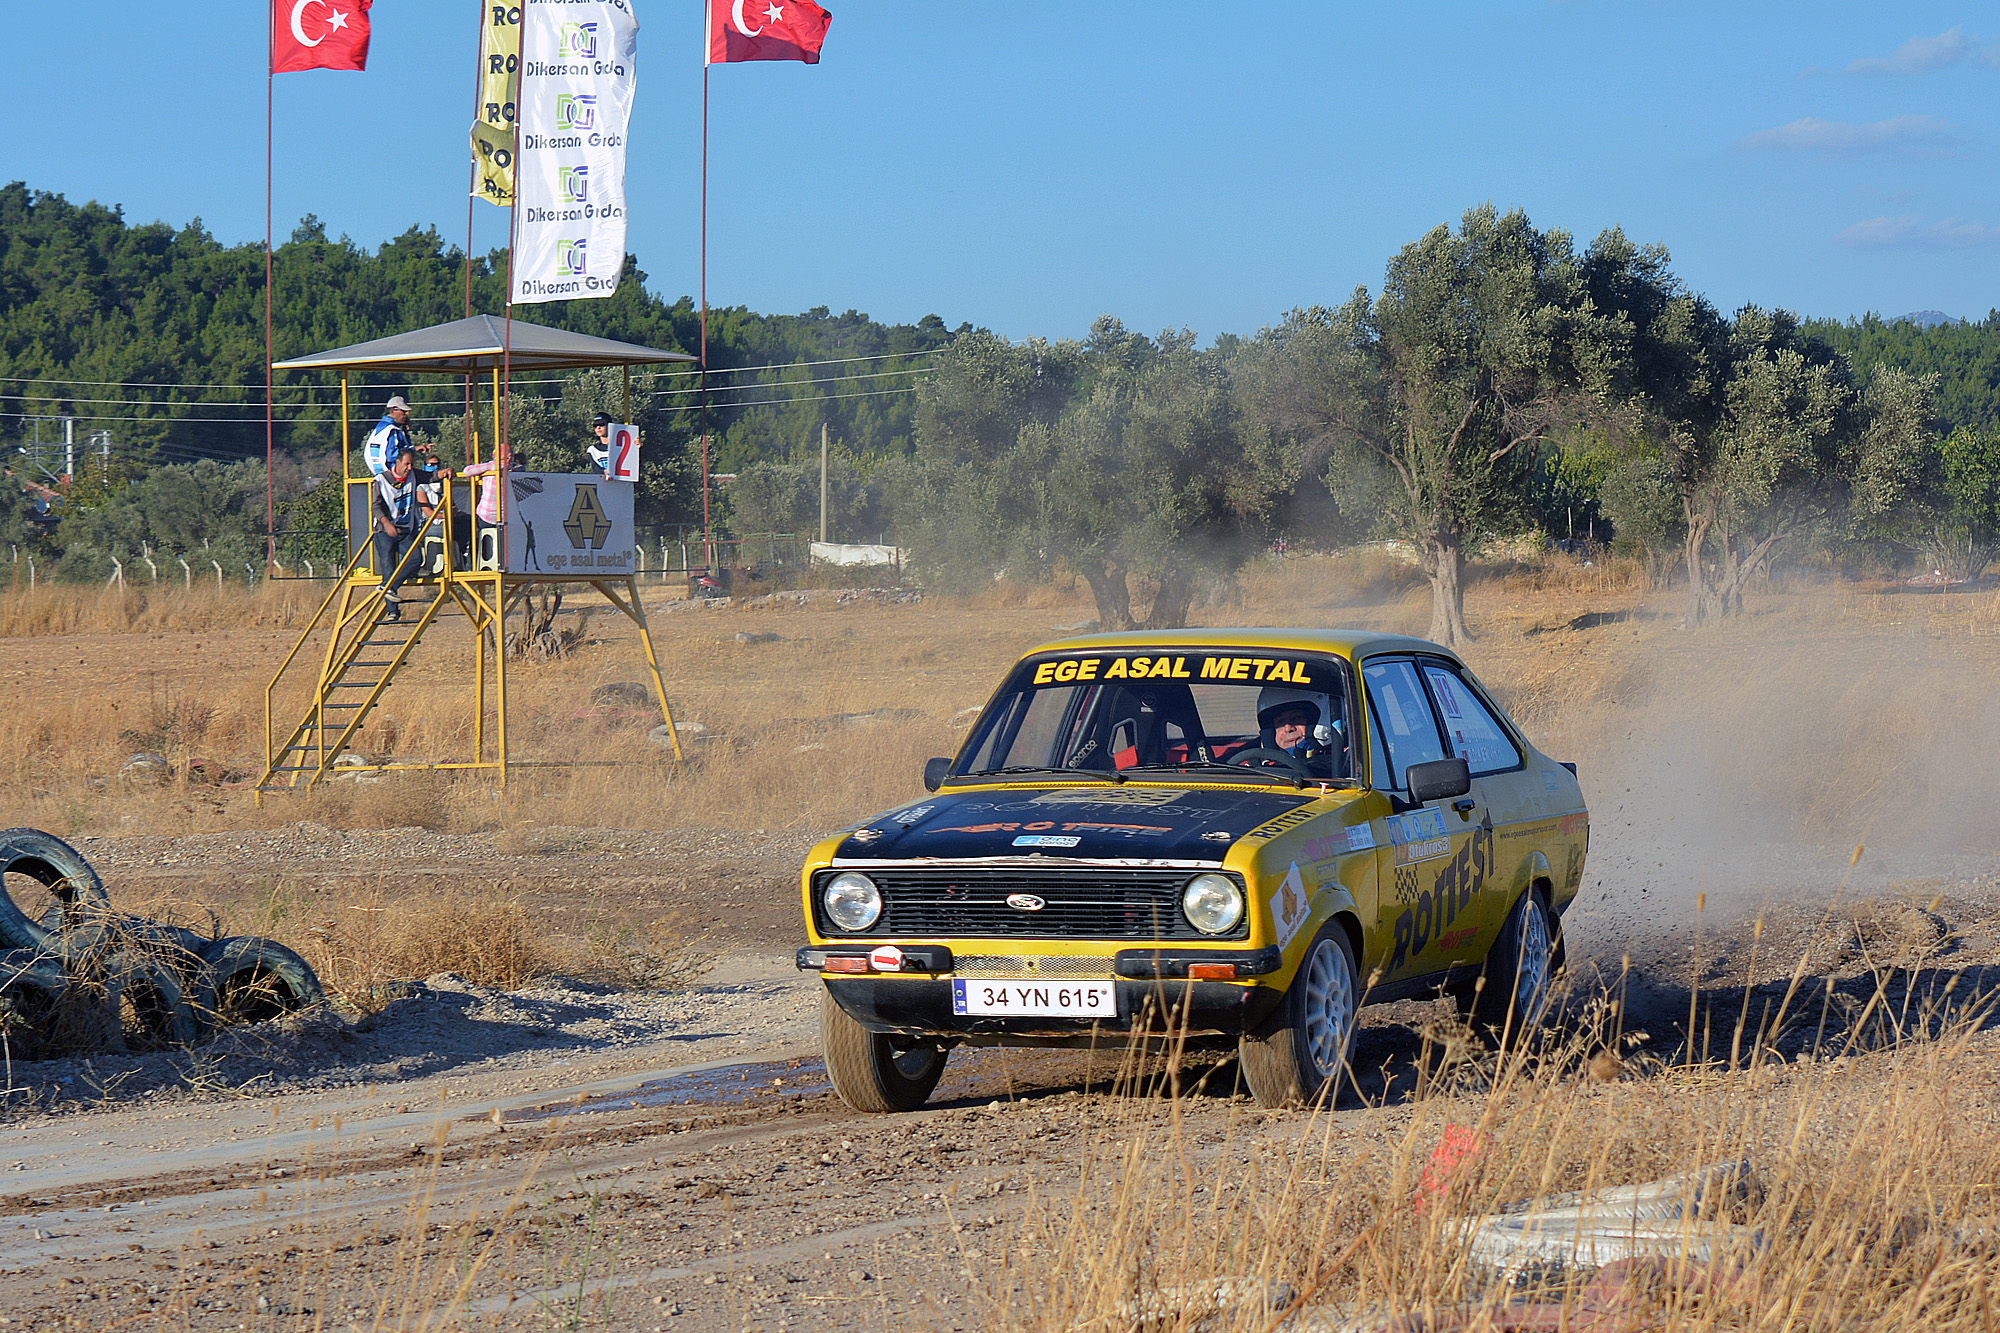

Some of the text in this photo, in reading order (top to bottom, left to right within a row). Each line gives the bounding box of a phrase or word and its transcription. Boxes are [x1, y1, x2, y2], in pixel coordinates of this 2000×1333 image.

[526, 62, 588, 77] Dikersan
[525, 135, 581, 150] Dikersan
[527, 208, 582, 223] Dikersan
[522, 280, 579, 295] Dikersan
[615, 430, 632, 476] 2
[546, 554, 567, 570] ege
[571, 550, 594, 566] asal
[1033, 657, 1311, 685] EGE ASAL METAL
[1251, 809, 1317, 840] ROTTEST
[1383, 808, 1494, 978] ROTTEST
[983, 988, 1100, 1008] 34 YN 615
